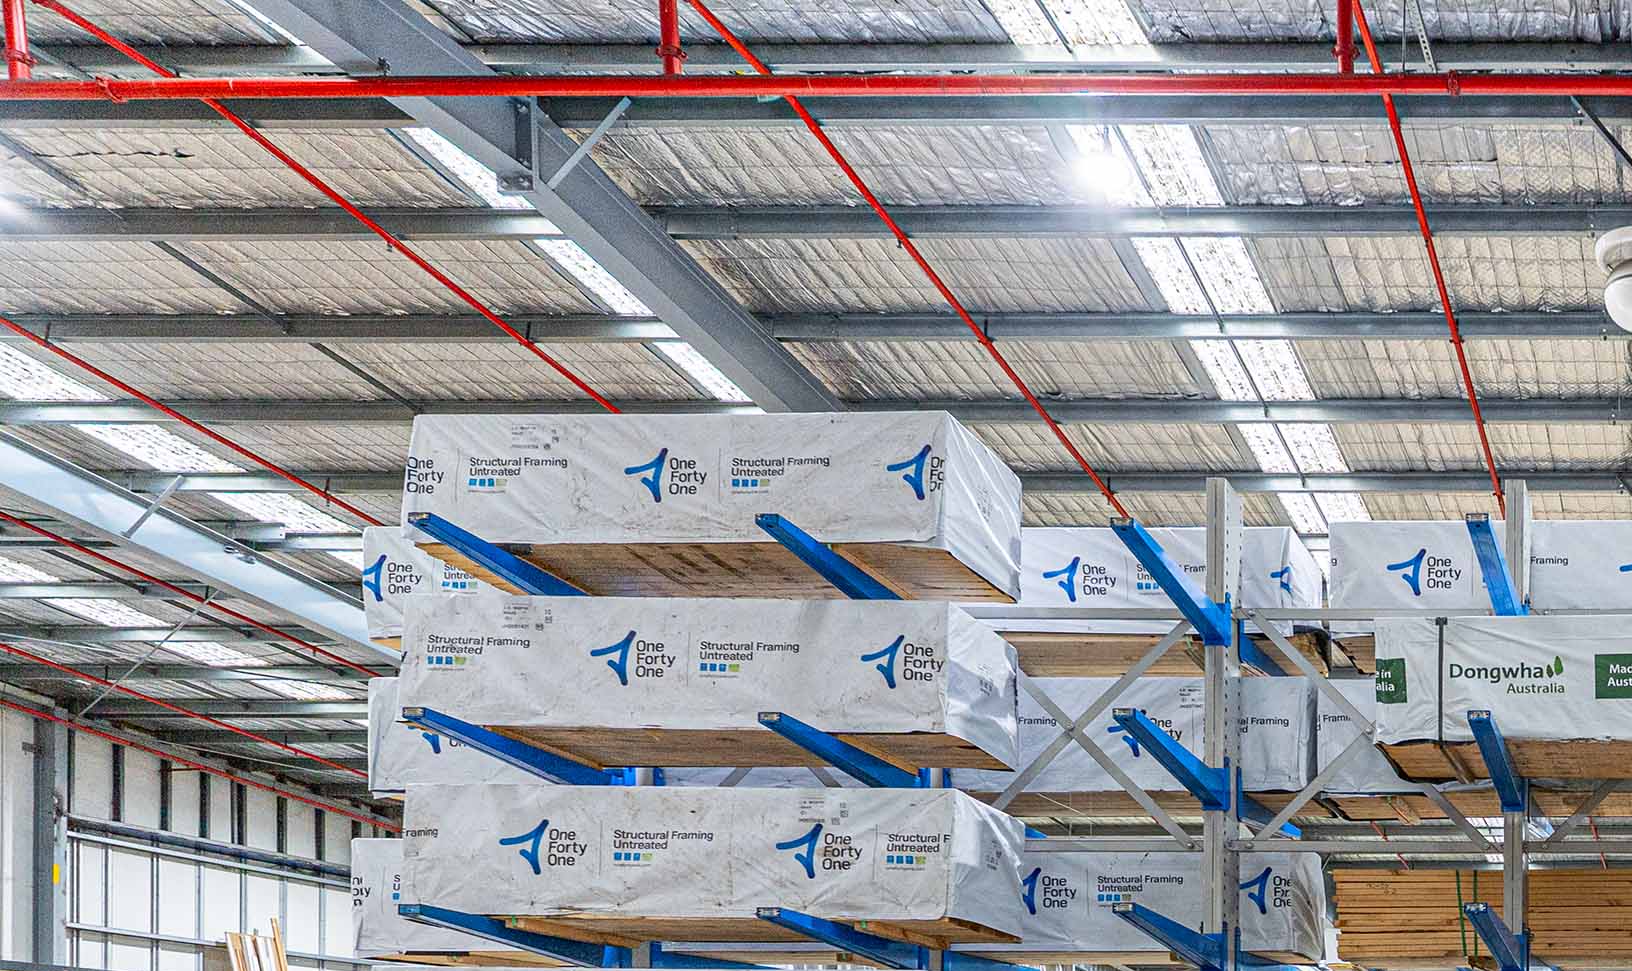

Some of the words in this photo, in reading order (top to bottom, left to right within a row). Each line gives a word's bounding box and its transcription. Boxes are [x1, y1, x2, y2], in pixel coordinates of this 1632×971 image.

[470, 457, 521, 466] Structural
[524, 457, 568, 468] Framing
[670, 458, 696, 470] One
[732, 457, 784, 467] Structural
[787, 458, 830, 467] Framing
[470, 467, 520, 476] Untreated
[732, 467, 784, 476] Untreated
[671, 471, 707, 485] Forty
[669, 483, 696, 494] One
[388, 562, 412, 572] One
[1427, 556, 1451, 567] One
[1082, 564, 1106, 575] One
[1428, 568, 1461, 580] Forty
[388, 573, 422, 584] Forty
[1083, 576, 1116, 588] Forty
[1427, 578, 1451, 589] One
[388, 584, 411, 594] One
[1083, 585, 1106, 595] One
[427, 635, 484, 646] Structural
[487, 637, 530, 648] Framing
[636, 640, 664, 652] One
[700, 641, 753, 650] Structural
[756, 642, 800, 653] Framing
[427, 646, 483, 656] Untreated
[904, 643, 933, 657] One
[637, 653, 676, 668] Forty
[700, 651, 753, 661] Untreated
[904, 656, 945, 672] Forty
[636, 666, 664, 678] One
[903, 668, 933, 681] One
[1450, 662, 1543, 683] Dongwha
[1507, 683, 1564, 694] Australia
[1251, 717, 1289, 727] Framing
[549, 829, 576, 840] One
[614, 830, 669, 839] Structural
[672, 831, 714, 842] Framing
[824, 833, 852, 845] One
[888, 834, 941, 844] Structural
[548, 842, 587, 856] Forty
[614, 840, 668, 849] Untreated
[887, 843, 940, 853] Untreated
[823, 846, 862, 860] Forty
[548, 854, 575, 866] One
[822, 858, 852, 870] One
[1042, 876, 1066, 886] One
[1097, 875, 1142, 884] Structural
[1145, 875, 1183, 885] Framing
[1044, 887, 1076, 899] Forty
[1098, 884, 1142, 892] Untreated
[1043, 898, 1068, 908] One
